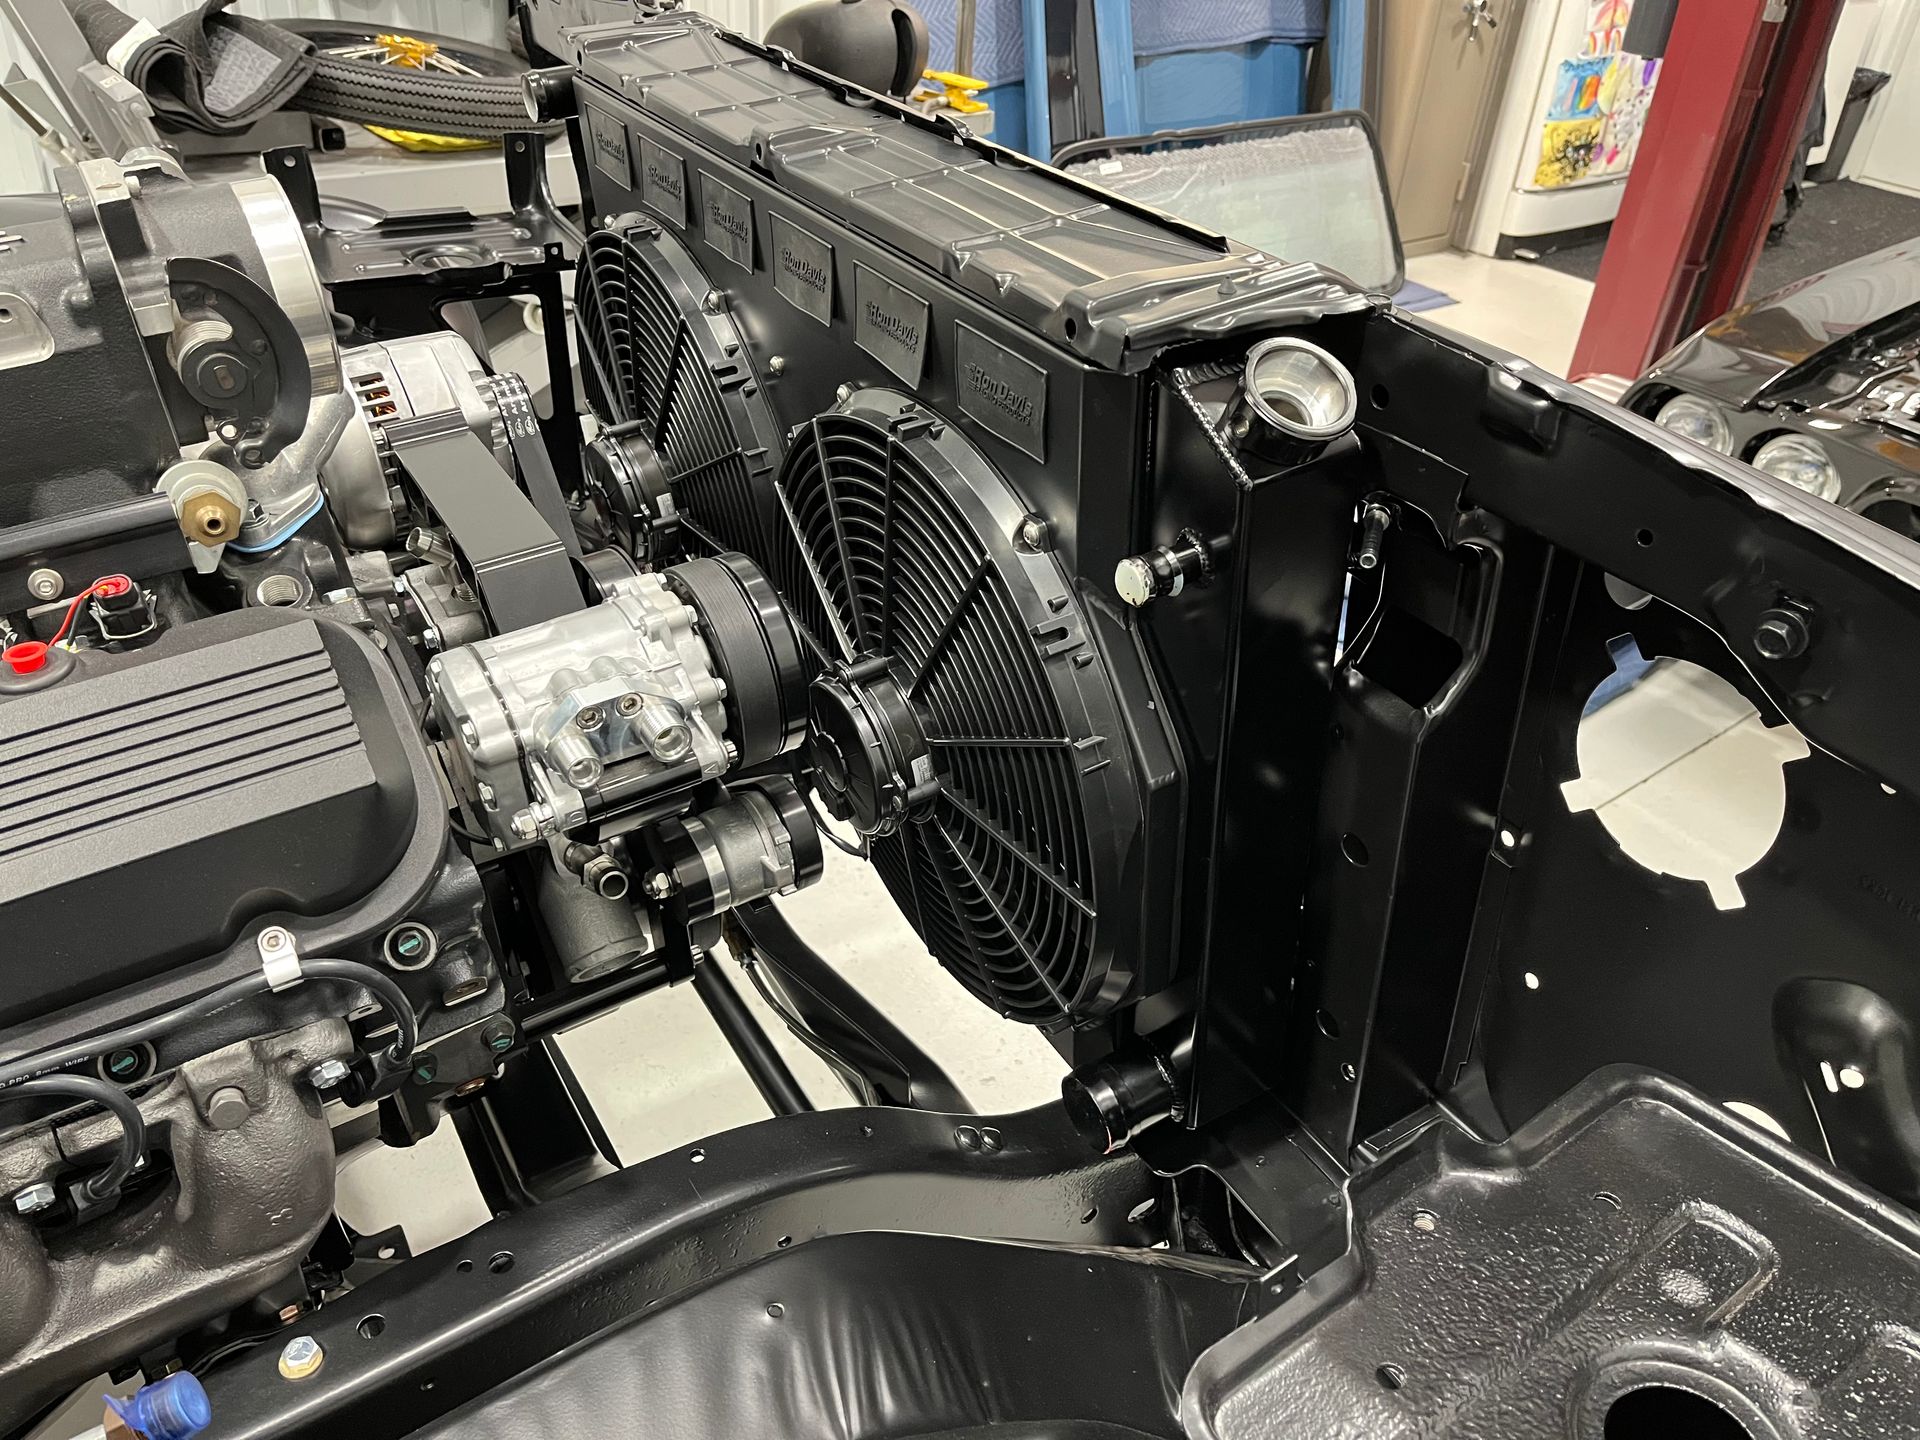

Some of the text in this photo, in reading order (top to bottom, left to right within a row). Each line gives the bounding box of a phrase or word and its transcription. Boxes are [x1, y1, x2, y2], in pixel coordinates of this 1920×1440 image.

[783, 248, 802, 272] Ron
[801, 258, 827, 286] Davis
[870, 302, 918, 344] Ron Davis
[974, 365, 1033, 416] Ron Davis
